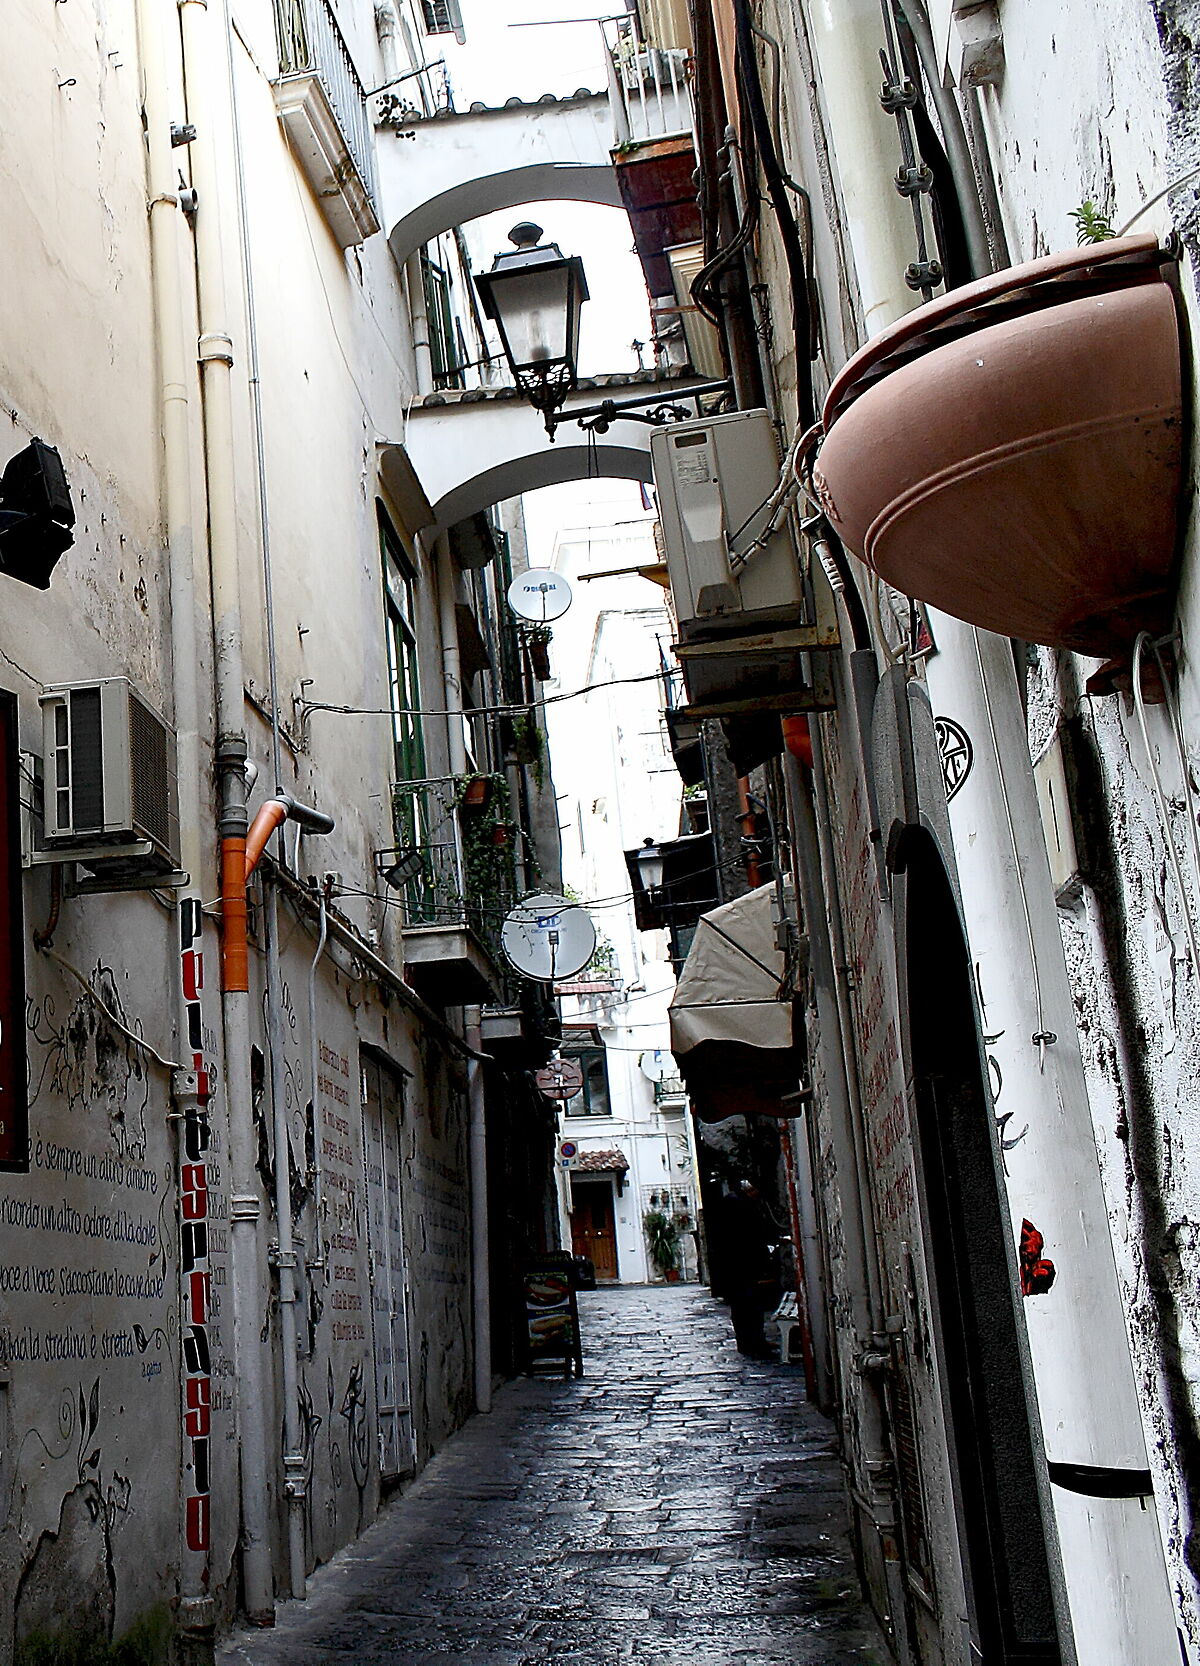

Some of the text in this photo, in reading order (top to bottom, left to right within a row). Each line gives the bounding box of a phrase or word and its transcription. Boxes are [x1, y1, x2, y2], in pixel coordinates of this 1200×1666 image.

[46, 1142, 82, 1180] sempre
[84, 1154, 97, 1179] un
[99, 1152, 124, 1185] altro
[126, 1166, 158, 1195] amore
[2, 1195, 39, 1229] ricordo
[41, 1205, 56, 1231] un
[57, 1199, 81, 1234] altro
[32, 1266, 56, 1294] voce
[29, 1327, 40, 1360] la
[44, 1326, 88, 1362] stradina
[101, 1329, 134, 1359] stretta
